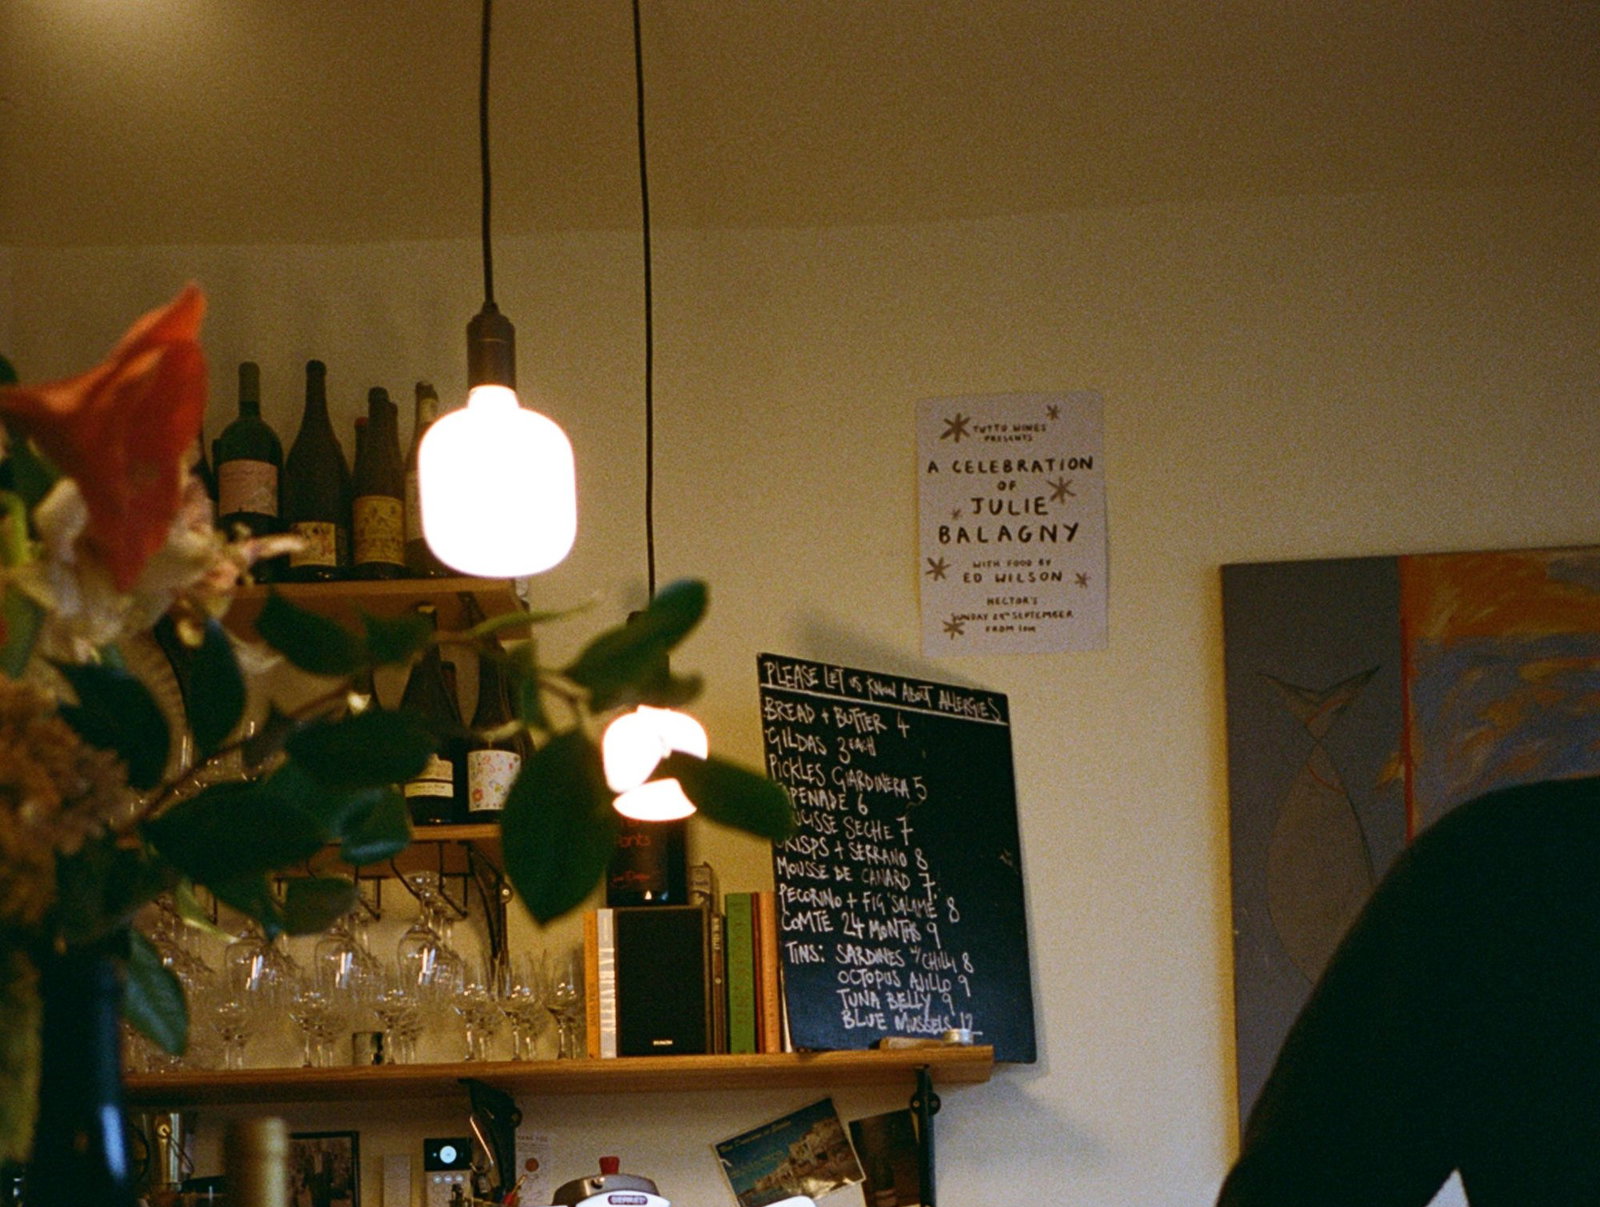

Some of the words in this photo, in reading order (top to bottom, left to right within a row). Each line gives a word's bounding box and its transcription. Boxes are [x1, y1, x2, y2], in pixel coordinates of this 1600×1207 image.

[927, 461, 939, 474] A
[952, 456, 1094, 474] CELEBRATION
[997, 480, 1017, 491] OF
[970, 496, 1049, 516] JULIE
[938, 522, 1079, 544] BALAGNY
[963, 572, 982, 583] ED
[994, 571, 1063, 583] WILSON
[973, 560, 1000, 568] WITH
[1007, 559, 1032, 567] FOOD
[1012, 611, 1073, 619] SEPTEMBER
[763, 661, 819, 687] PLEASE
[824, 660, 844, 693] LET
[764, 698, 816, 724] BREAD
[833, 706, 887, 734] BUTTER
[897, 713, 910, 738] 4
[765, 727, 827, 756] GILDAS
[769, 753, 826, 787] PICKLES
[912, 776, 927, 800] 5
[779, 782, 849, 812] PENADE
[858, 793, 868, 815] 6
[897, 816, 914, 846] 7
[849, 842, 907, 866] SERRANO
[916, 849, 928, 870] 8
[777, 856, 829, 880] MOUSSE
[834, 866, 853, 882] DE
[861, 868, 911, 891] CANARD
[918, 873, 936, 903] 7
[778, 883, 842, 912] PECORINO
[862, 892, 886, 916] FIG
[947, 896, 960, 923] 8
[841, 912, 864, 939] 24
[868, 917, 922, 943] MONTHS
[926, 922, 941, 949] 9
[785, 941, 825, 964] TINS:
[835, 943, 905, 968] SARDINES
[962, 952, 975, 974] 8
[837, 968, 901, 990] OCTOPUS
[909, 972, 951, 993] AJILLO
[957, 974, 971, 998] 9
[836, 987, 881, 1011] TUNA
[886, 989, 931, 1022] BELLY
[941, 993, 956, 1016] 9
[841, 1008, 887, 1031] BLUE
[894, 1011, 952, 1035] MUSSELS
